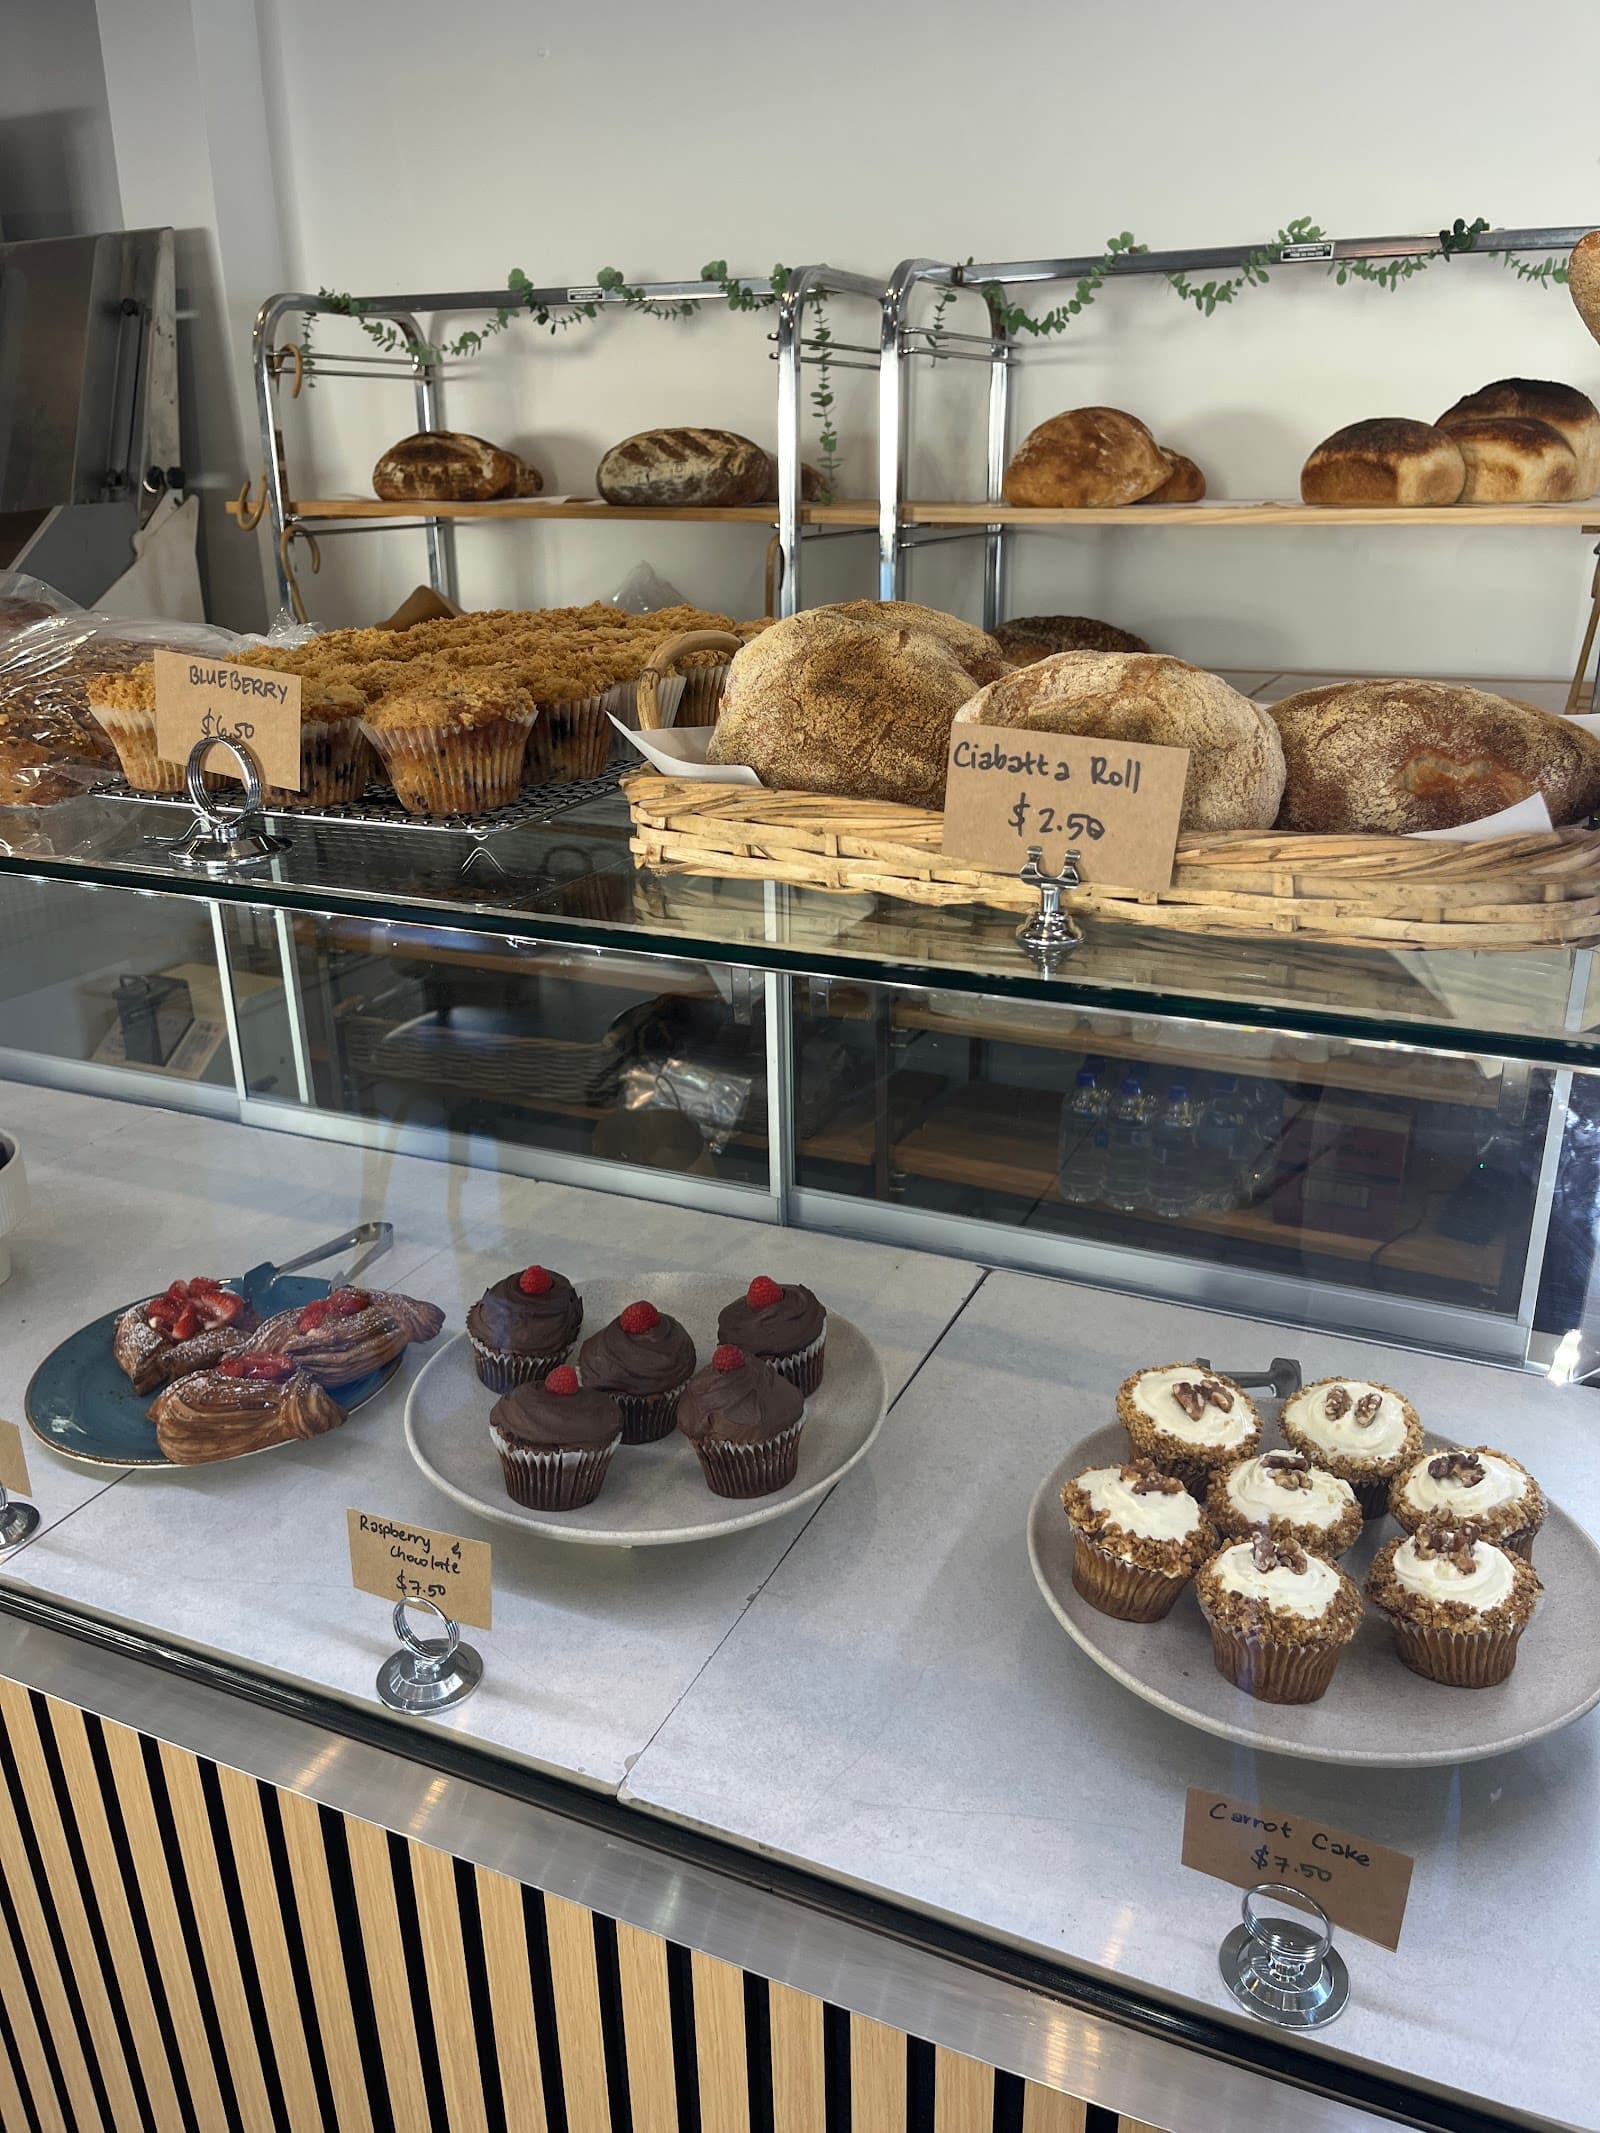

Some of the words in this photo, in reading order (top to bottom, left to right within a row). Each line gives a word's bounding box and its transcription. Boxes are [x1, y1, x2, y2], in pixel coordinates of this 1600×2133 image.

[189, 665, 288, 704] BLUEBERRY
[201, 708, 255, 740] $6.50
[953, 741, 1070, 781] Ciabatta
[1090, 756, 1141, 794] Roll
[360, 1515, 431, 1554] Raspberry
[451, 1542, 462, 1560] &
[390, 1545, 461, 1574] Chocolate
[396, 1569, 446, 1597] $7.50
[1209, 1803, 1292, 1838] Carrot
[1311, 1833, 1371, 1867] Cake
[1250, 1845, 1333, 1883] $7.50
